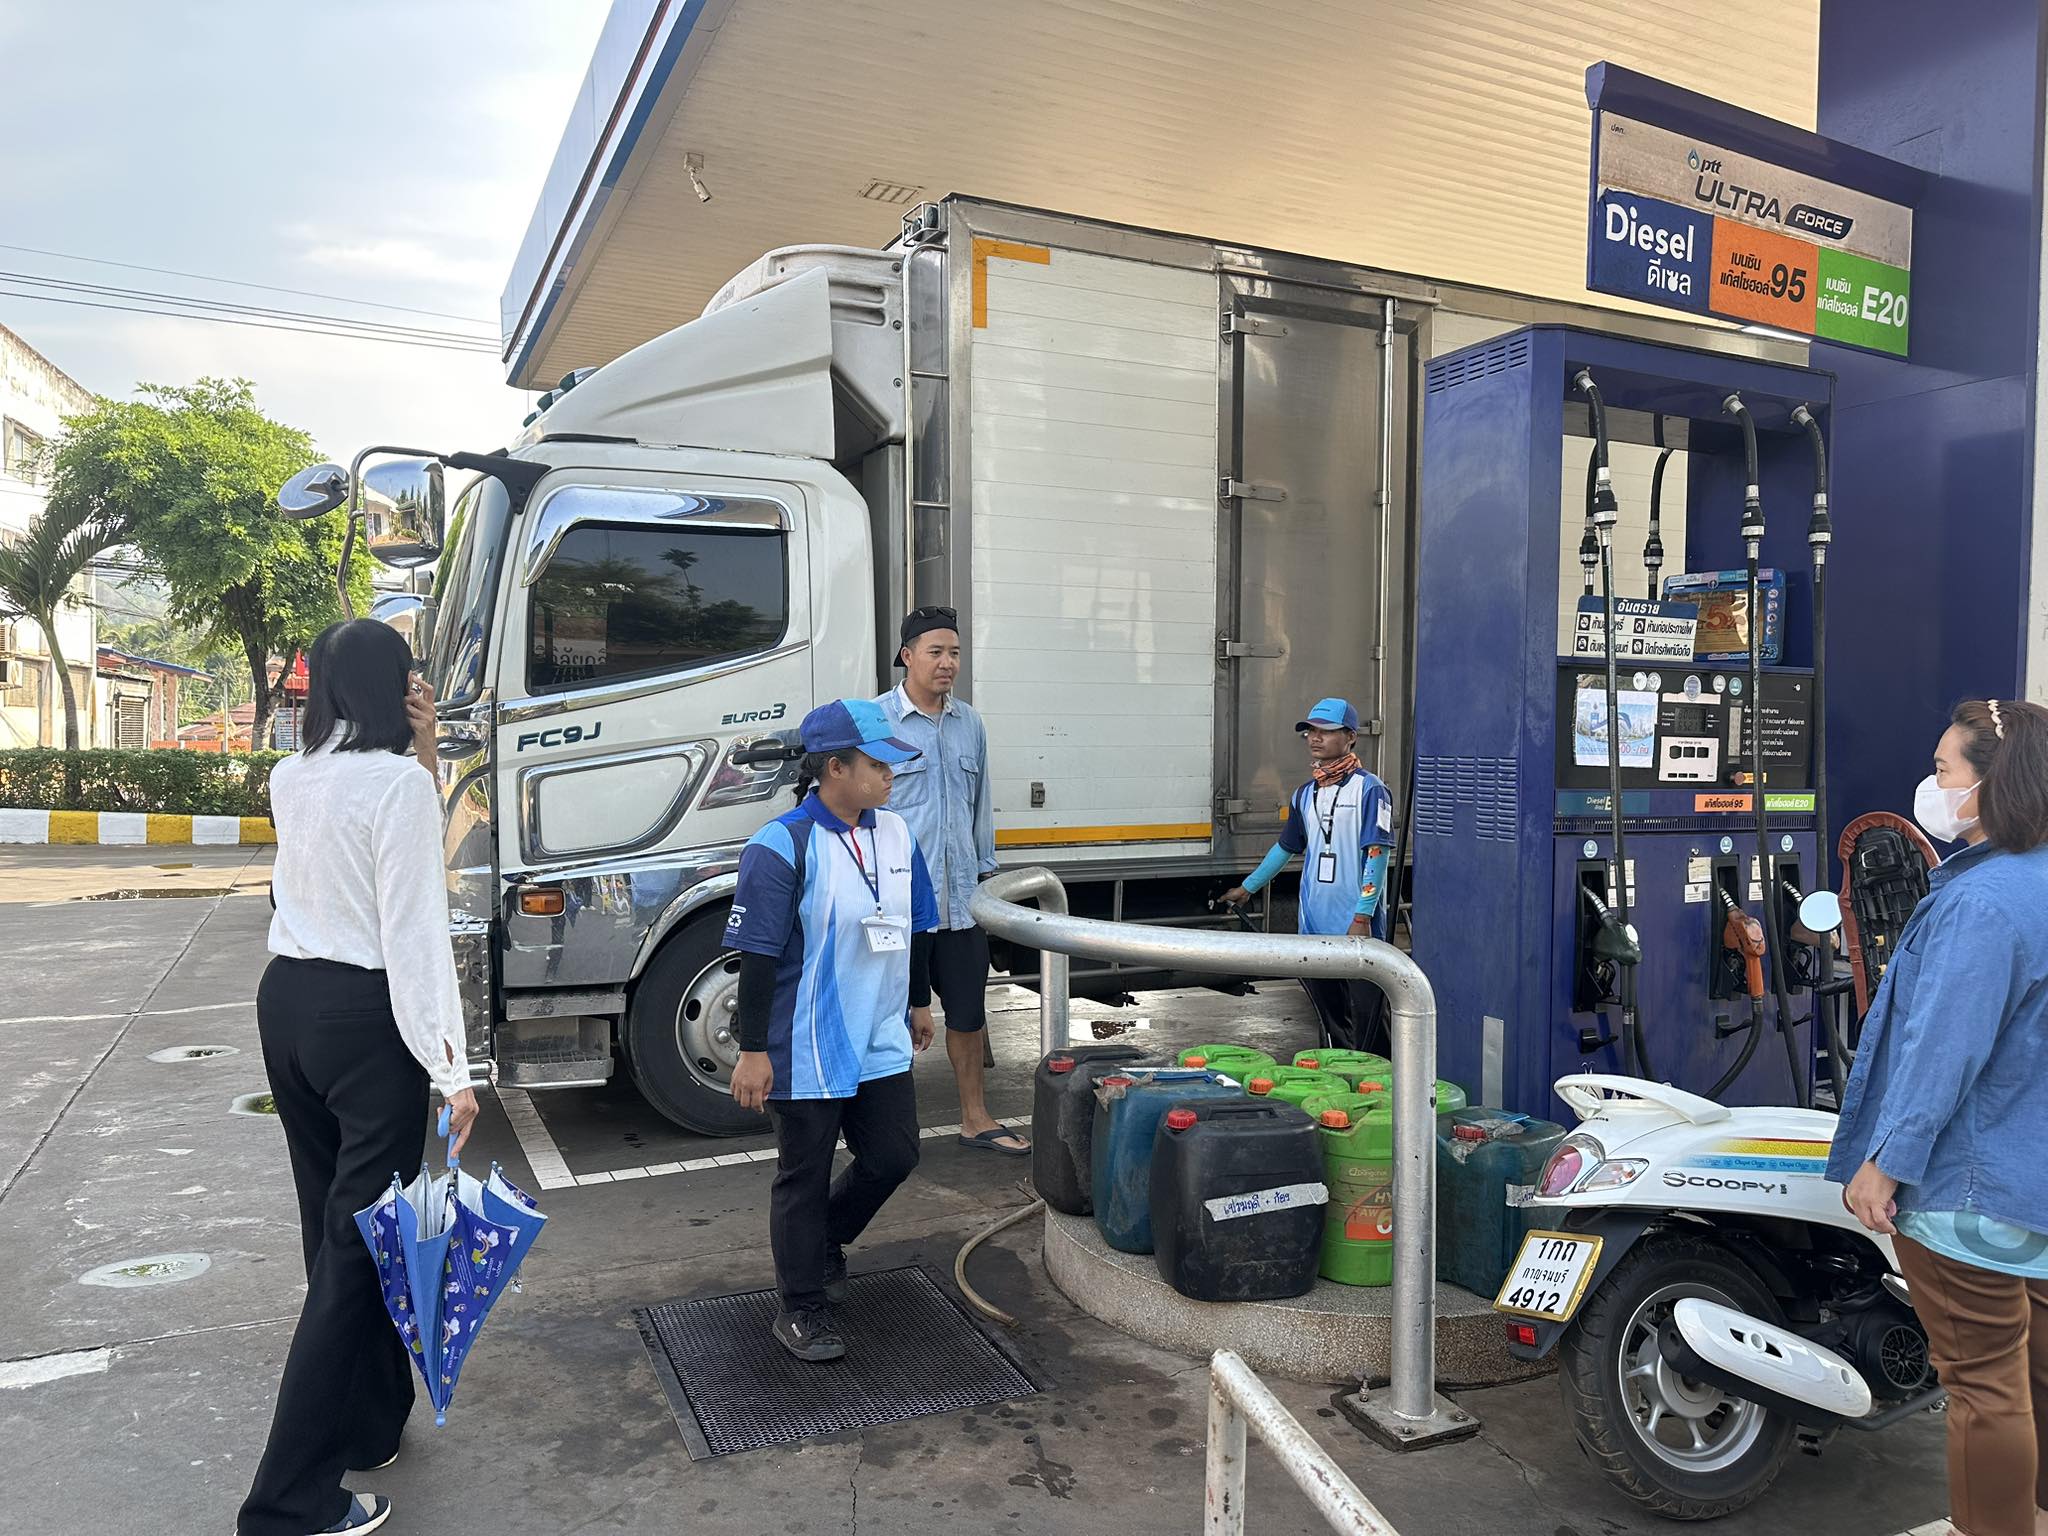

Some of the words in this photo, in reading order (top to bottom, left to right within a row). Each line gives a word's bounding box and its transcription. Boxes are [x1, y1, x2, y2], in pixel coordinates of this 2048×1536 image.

[1700, 160, 1721, 174] ptt
[1695, 175, 1780, 223] ULTRA
[1795, 210, 1844, 234] FORCE
[1606, 203, 1694, 262] Diesel
[1731, 252, 1761, 271] เบนซิน
[1647, 258, 1691, 295] ดีเซล
[1770, 264, 1807, 302] 95
[1826, 277, 1851, 294] เบนซิน
[1861, 285, 1908, 327] E20
[1617, 599, 1660, 615] อันตราย
[721, 703, 787, 725] EURO3
[516, 721, 602, 752] FC9J
[1586, 796, 1605, 804] Diesel
[1522, 1268, 1569, 1287] กาญจนบุรี
[1508, 1287, 1560, 1313] 4912
